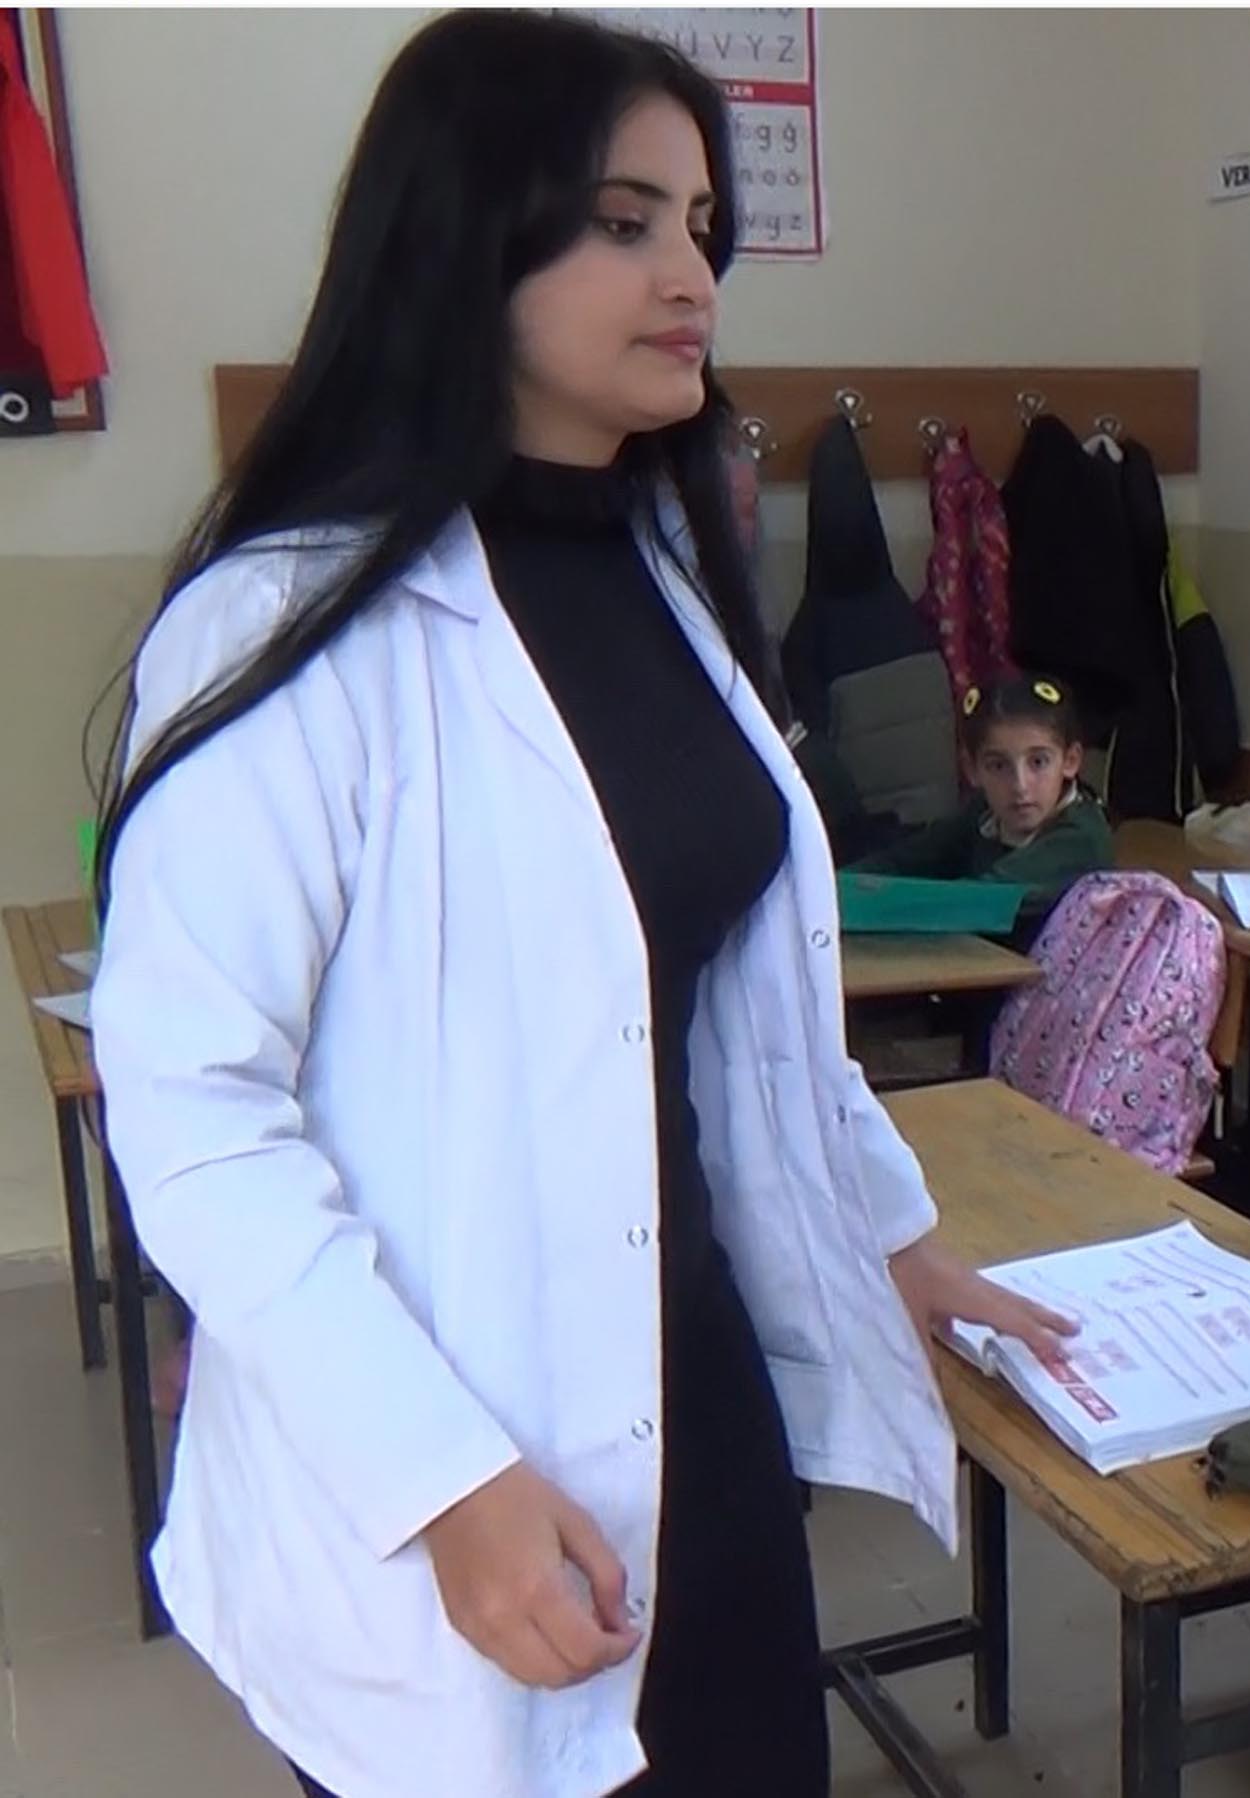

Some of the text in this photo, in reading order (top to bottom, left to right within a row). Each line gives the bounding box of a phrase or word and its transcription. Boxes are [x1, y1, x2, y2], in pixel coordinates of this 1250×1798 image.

[711, 31, 733, 60] V
[745, 32, 765, 62] Y
[775, 34, 797, 64] Z
